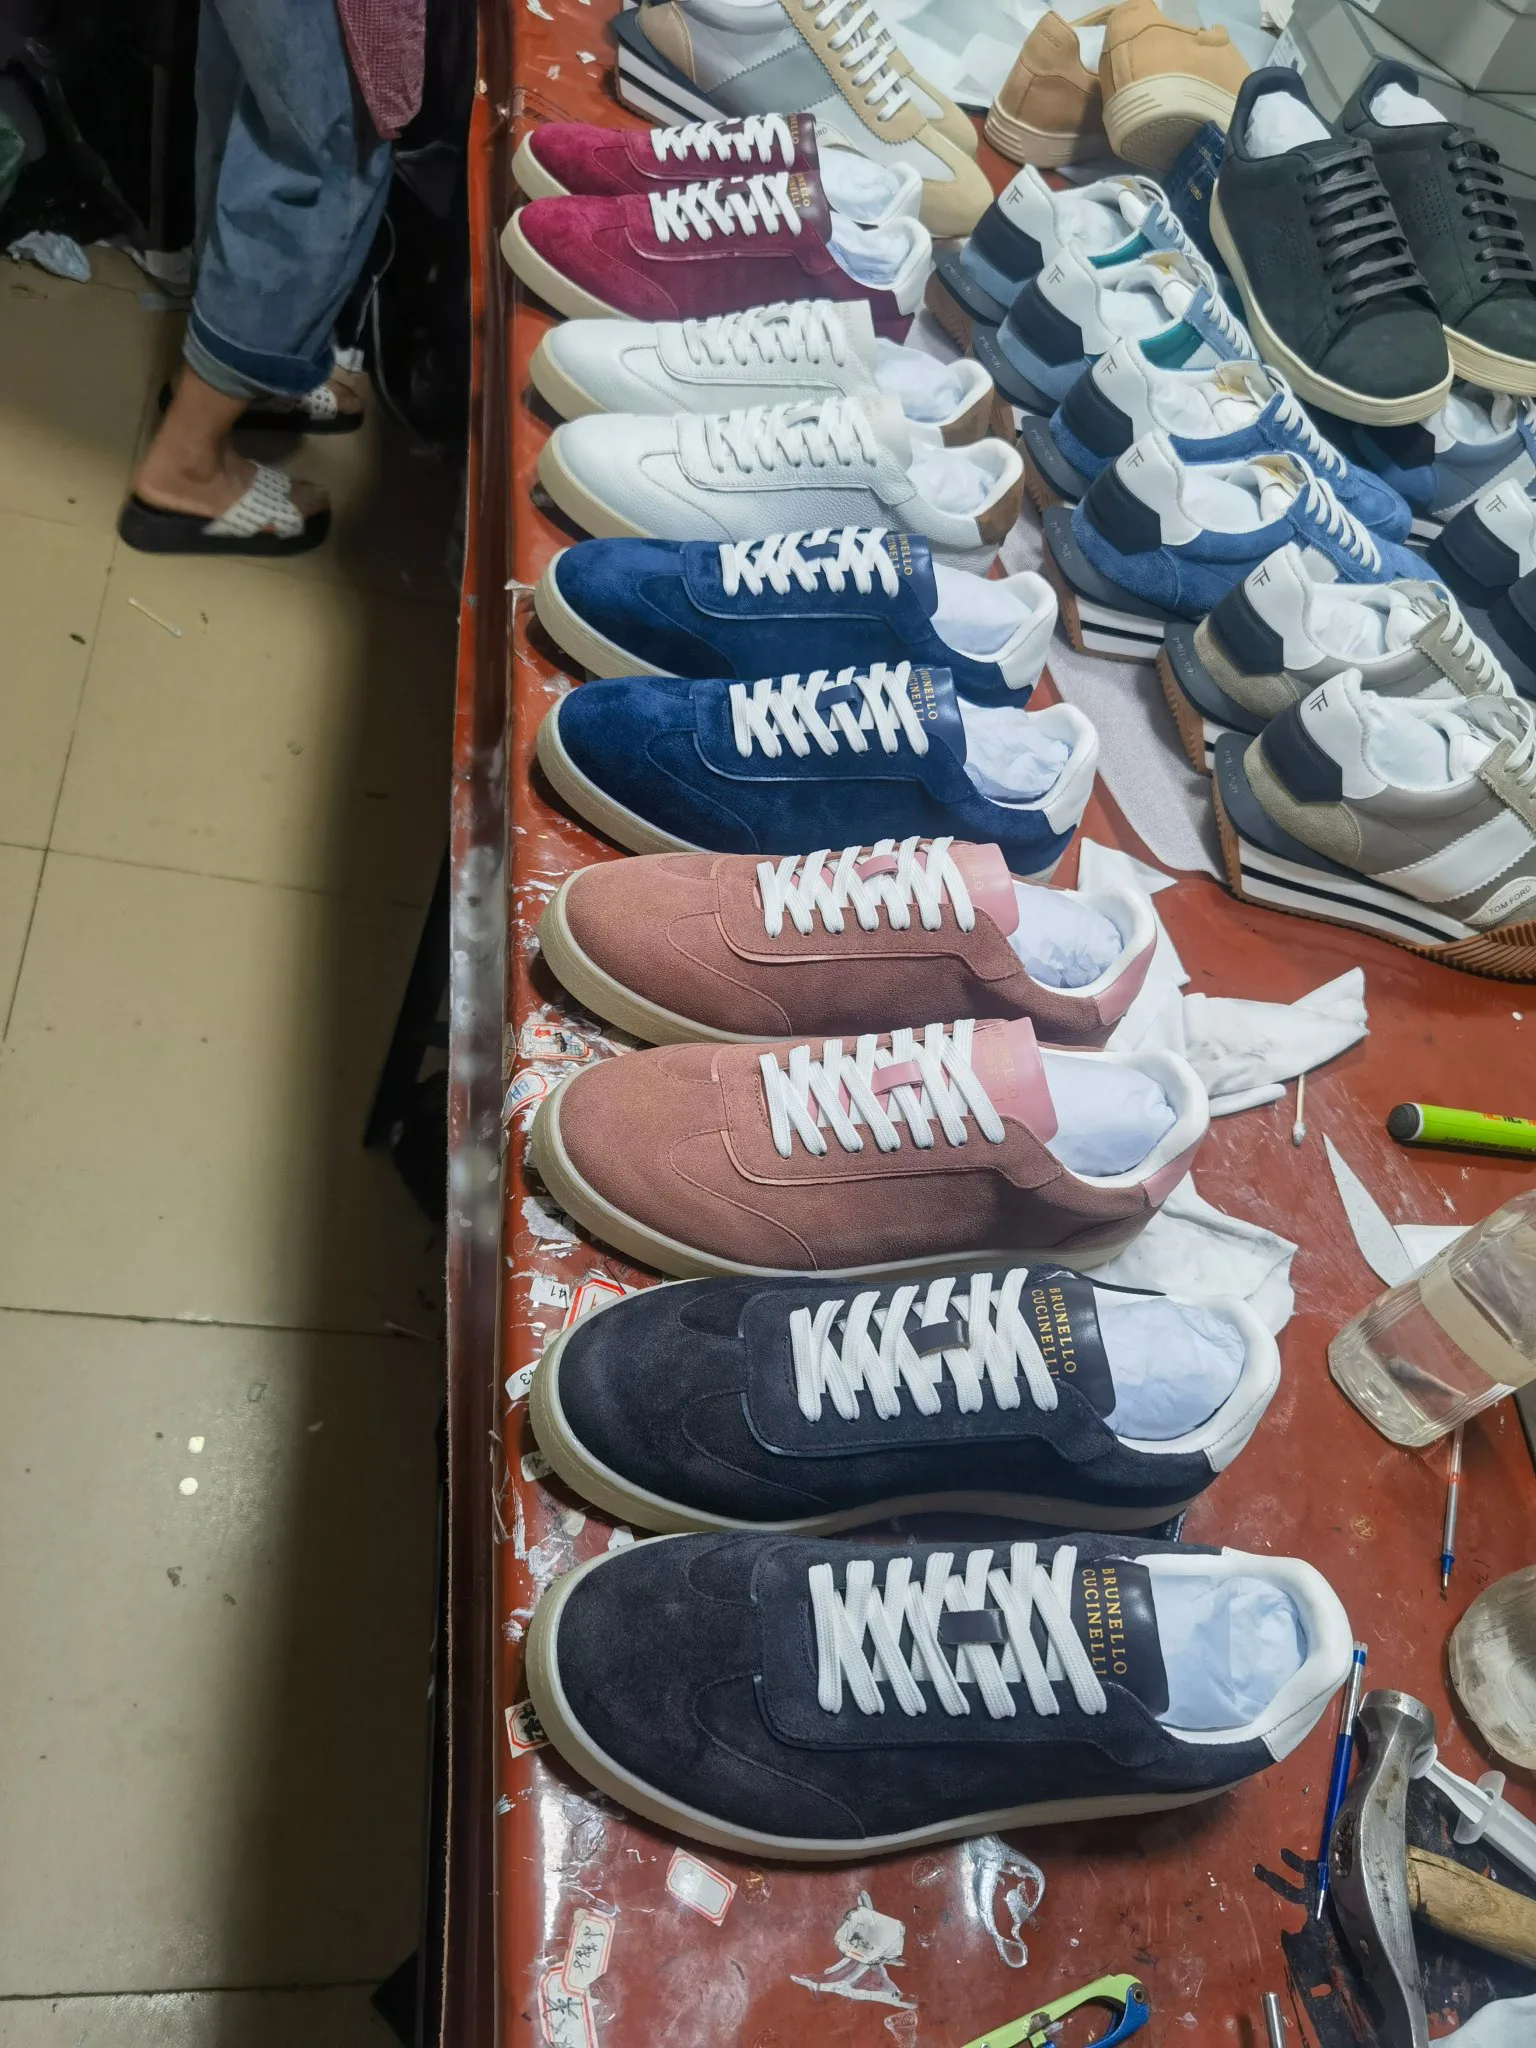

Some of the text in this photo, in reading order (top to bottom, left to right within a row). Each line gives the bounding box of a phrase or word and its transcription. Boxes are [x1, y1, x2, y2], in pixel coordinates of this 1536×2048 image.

[1488, 885, 1531, 915] TOM FORD
[1049, 1287, 1077, 1374] BRUNELLO
[1082, 1569, 1107, 1676] CUCINELLI
[1101, 1567, 1128, 1675] BRUNELLO
